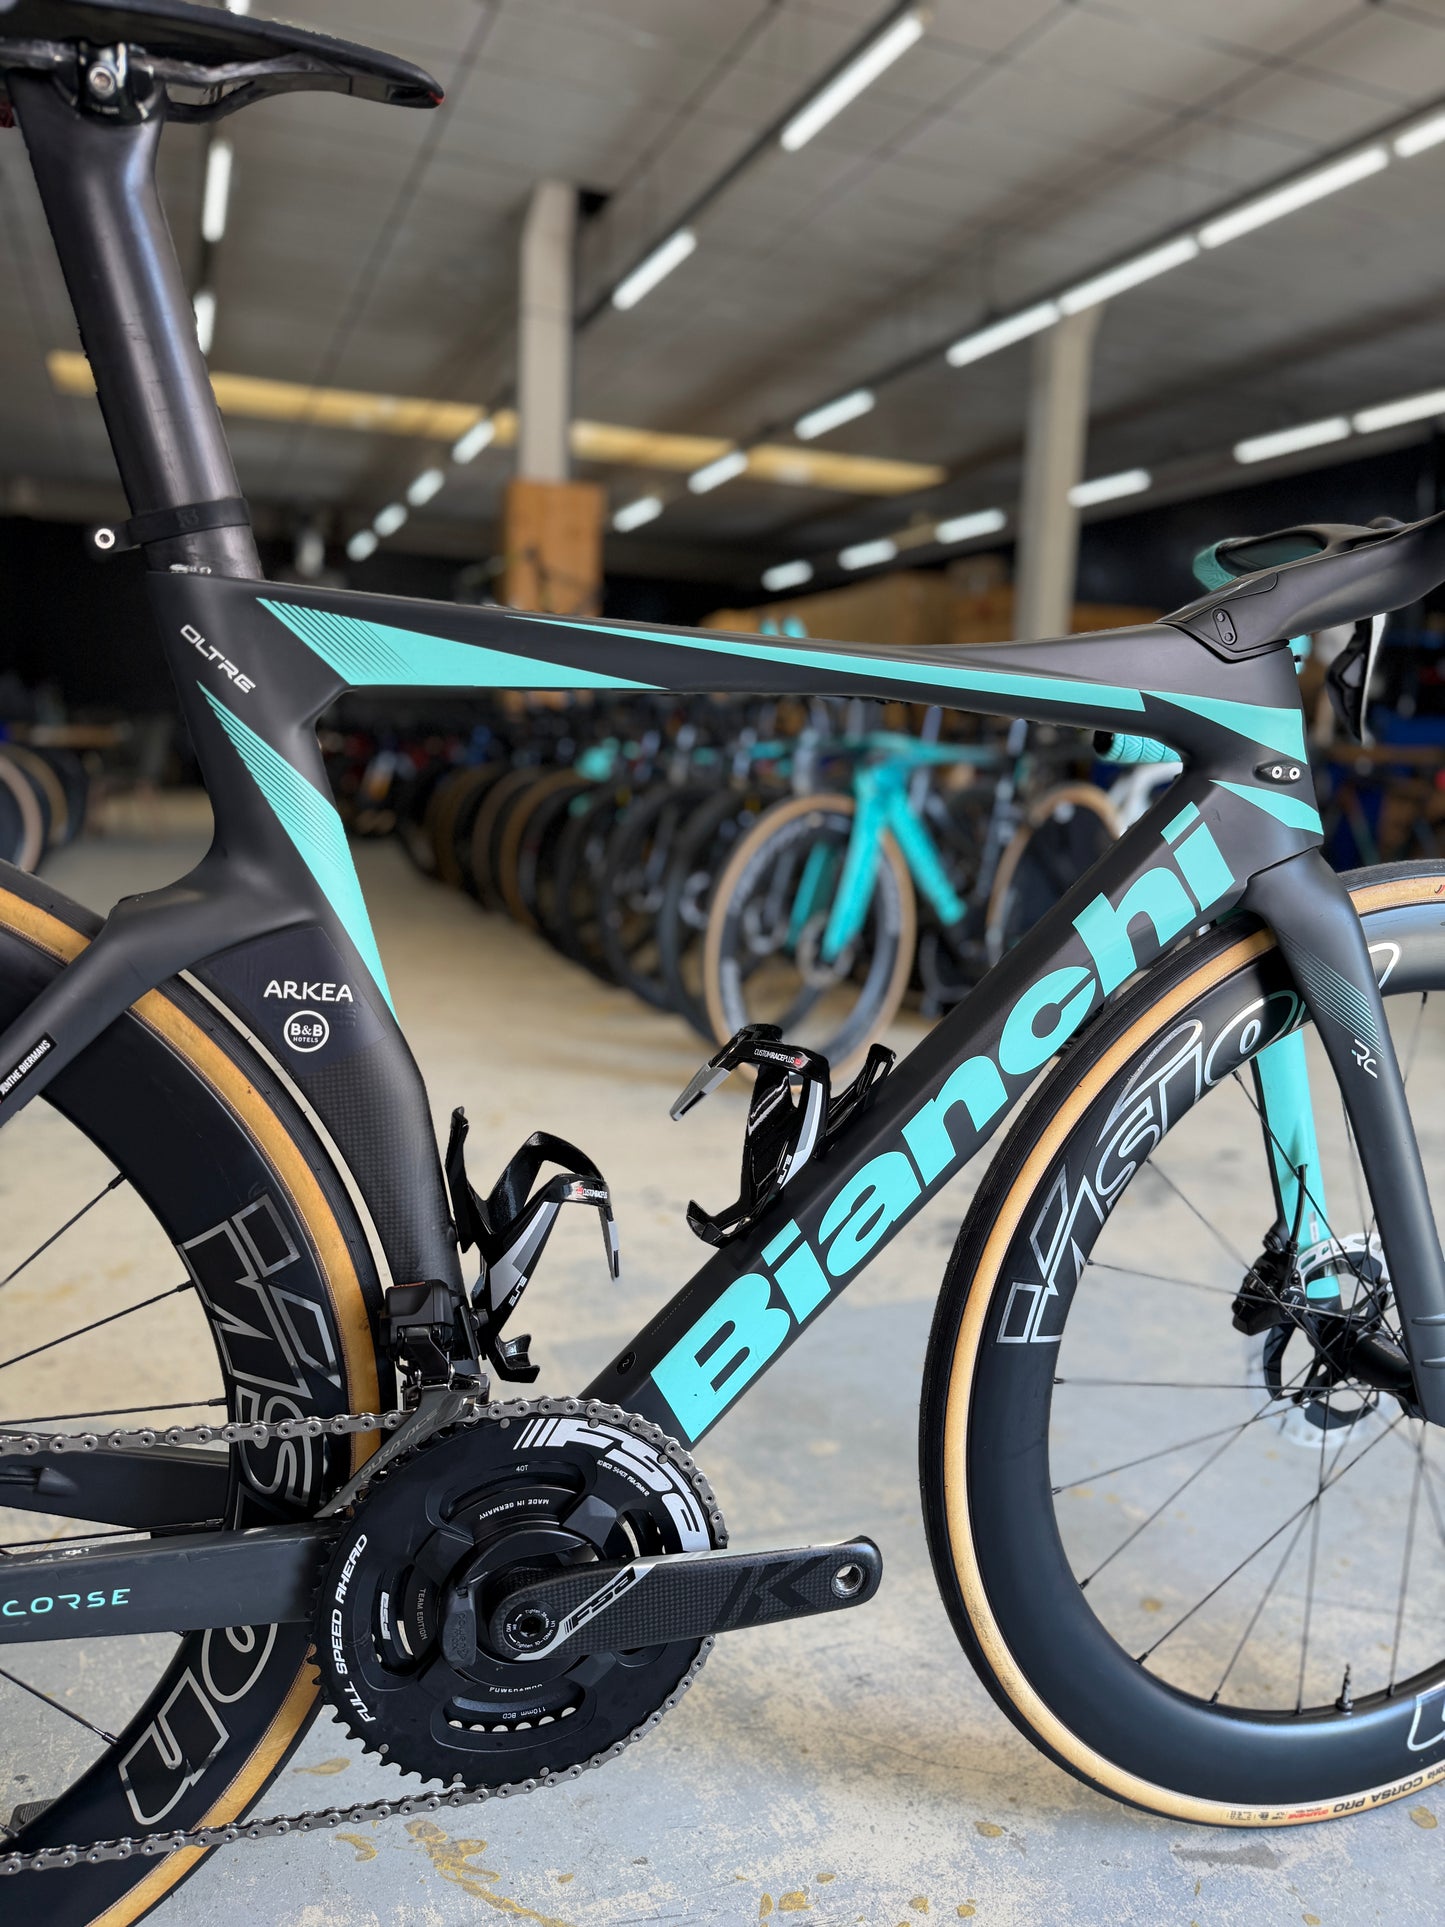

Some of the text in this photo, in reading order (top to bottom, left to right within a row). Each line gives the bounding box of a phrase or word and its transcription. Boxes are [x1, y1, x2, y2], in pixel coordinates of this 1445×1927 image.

[180, 624, 256, 693] OLTRE
[263, 979, 354, 1002] ARKEA
[290, 1023, 323, 1037] B&B
[18, 1040, 51, 1074] BIERMANS
[650, 801, 1236, 1442] Bianchi
[515, 1464, 528, 1472] 40T
[479, 1502, 515, 1520] GERMANY
[516, 1499, 525, 1507] IN
[2, 1588, 131, 1617] CORSE
[416, 1588, 427, 1640] TEAM EDITION
[331, 1534, 377, 1722] FULL SPEED AHEAD
[502, 1706, 546, 1720] 110mm BCD
[1371, 1776, 1423, 1803] CORSA
[1333, 1797, 1366, 1813] PRO
